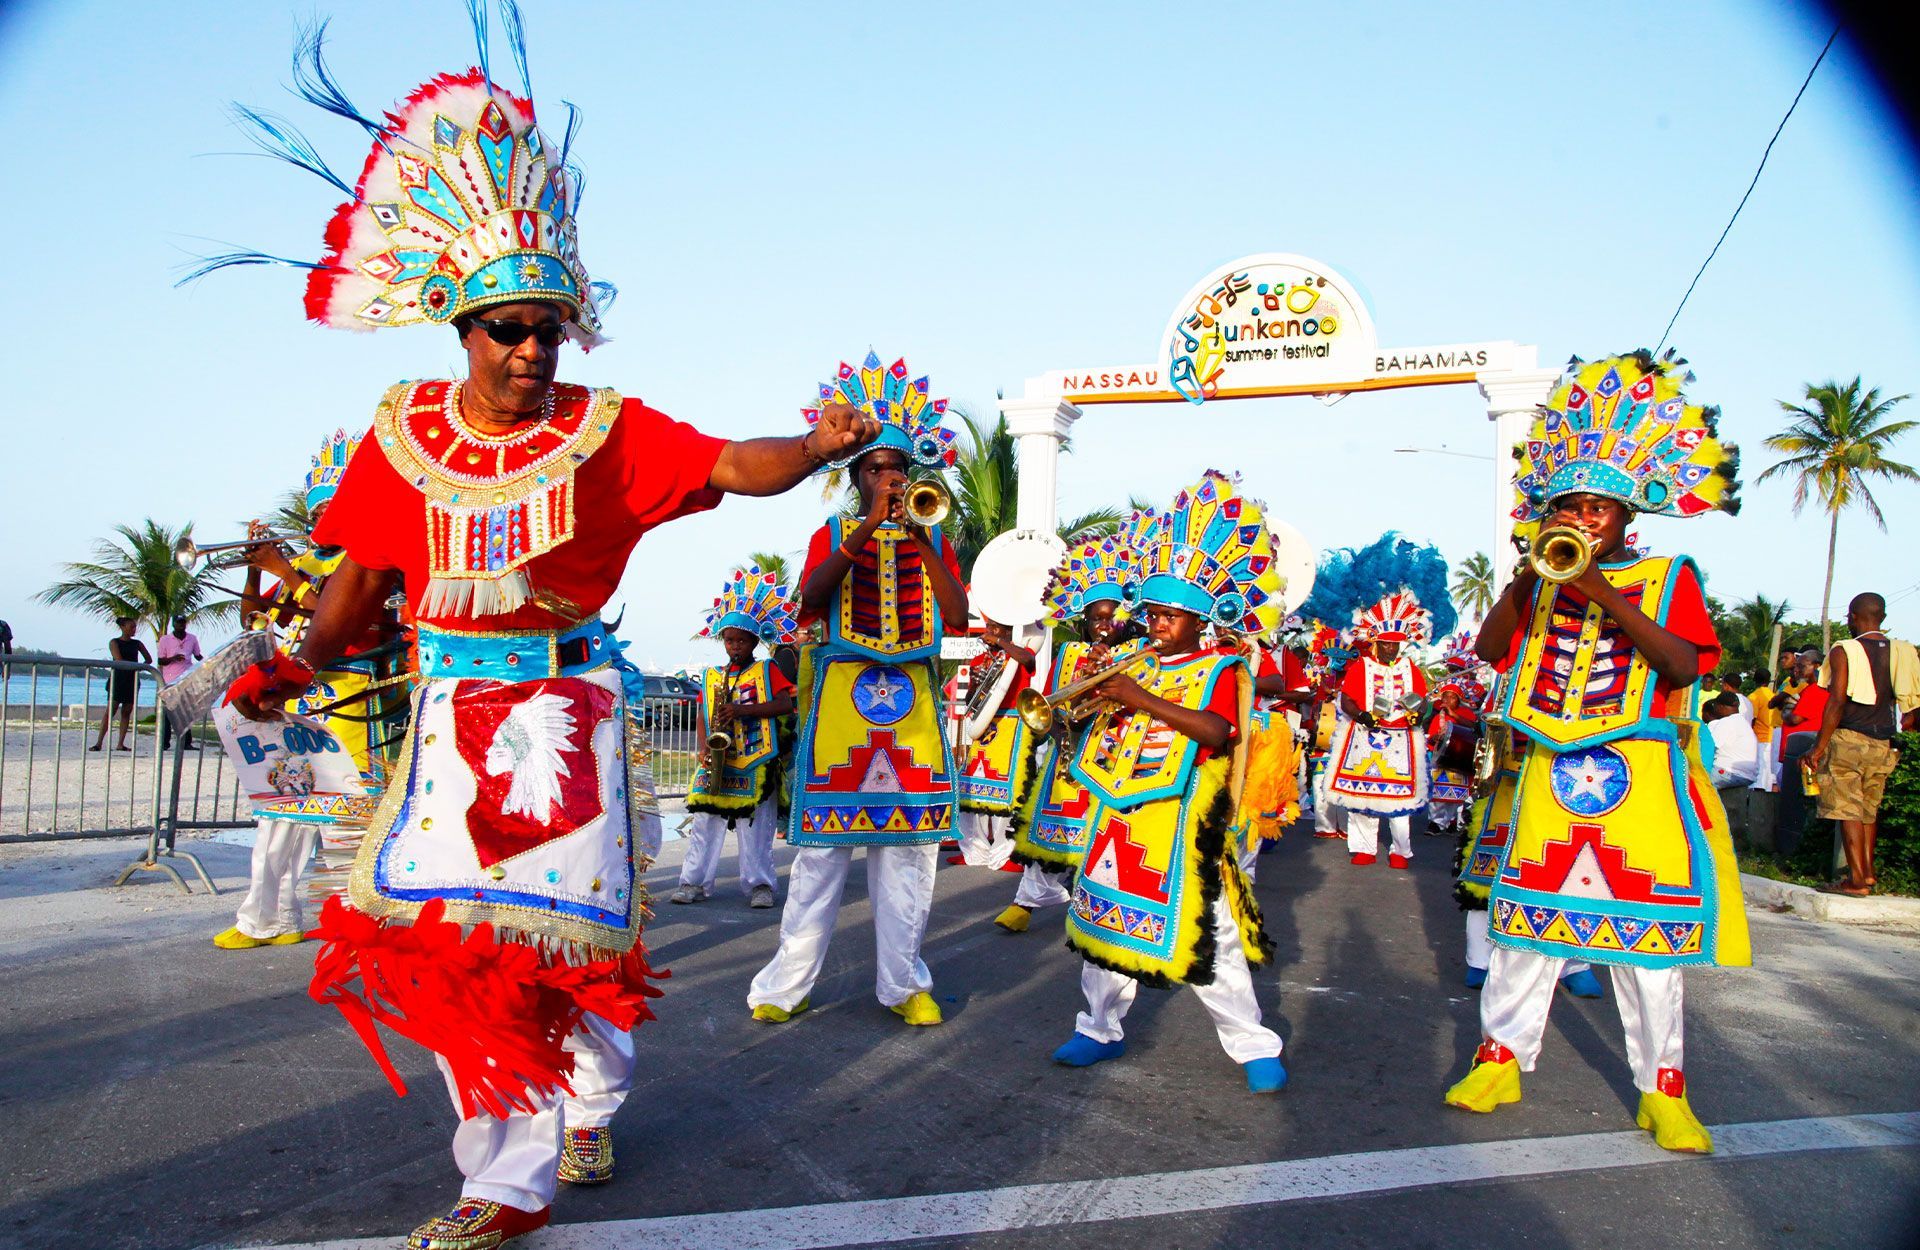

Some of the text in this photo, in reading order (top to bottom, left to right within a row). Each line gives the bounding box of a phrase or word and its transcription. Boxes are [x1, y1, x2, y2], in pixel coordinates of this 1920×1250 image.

[1214, 316, 1337, 347] junkanoo
[1225, 342, 1330, 362] summer festival
[1375, 350, 1488, 372] BAHAMAS
[1064, 370, 1158, 389] NASSAU
